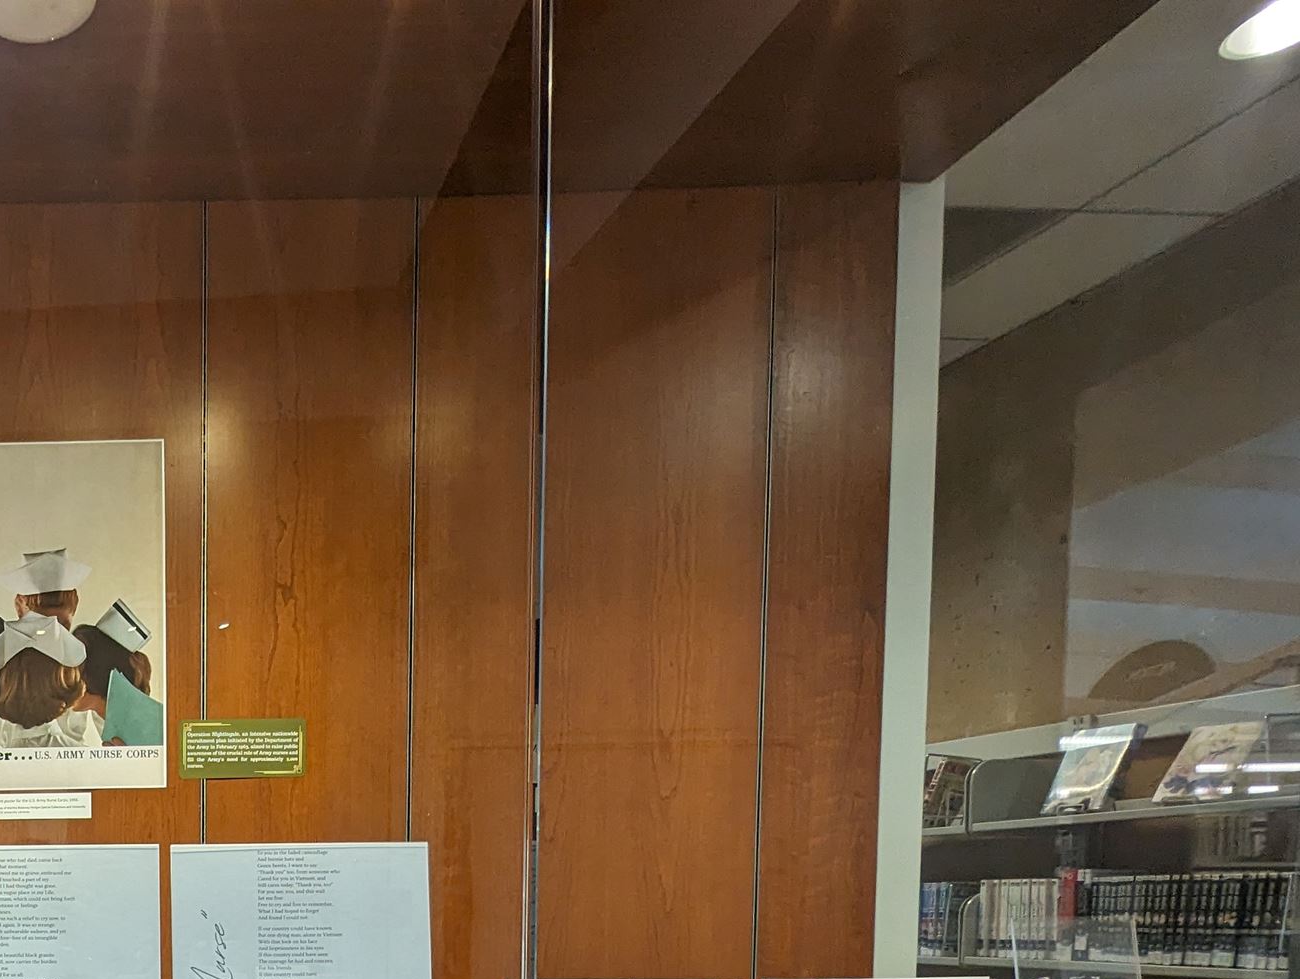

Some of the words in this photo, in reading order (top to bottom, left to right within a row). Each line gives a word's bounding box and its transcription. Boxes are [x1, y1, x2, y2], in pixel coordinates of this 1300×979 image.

[34, 751, 52, 760] U.S.
[56, 750, 84, 760] ARMY
[89, 750, 123, 759] NURSE
[126, 749, 159, 759] CORPS
